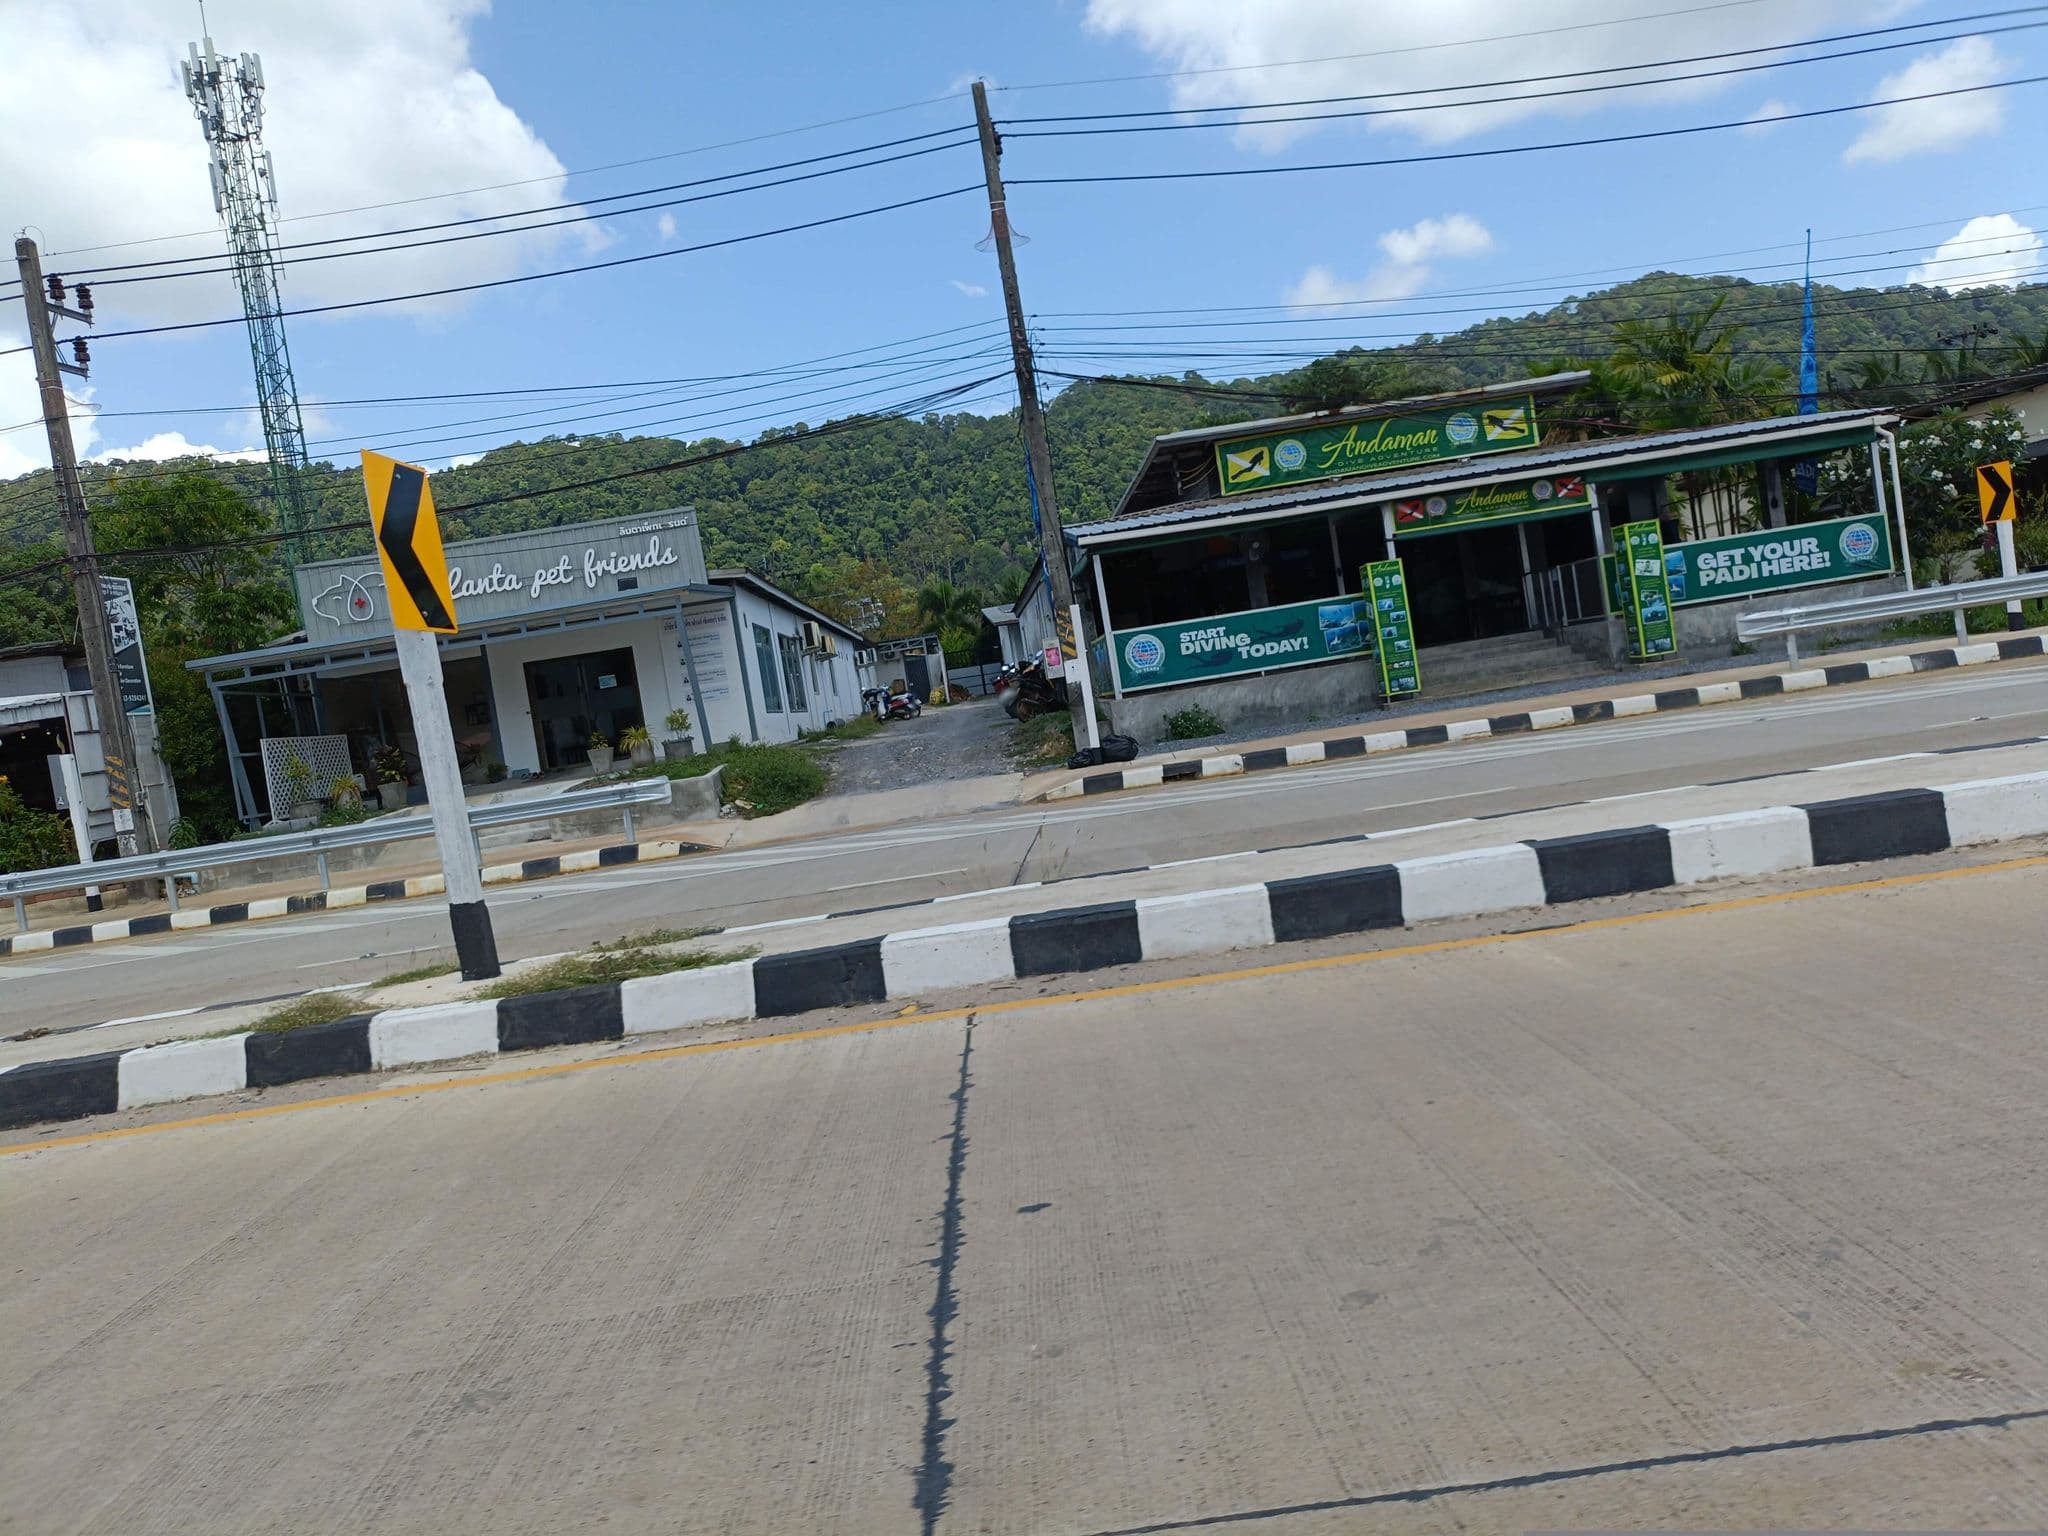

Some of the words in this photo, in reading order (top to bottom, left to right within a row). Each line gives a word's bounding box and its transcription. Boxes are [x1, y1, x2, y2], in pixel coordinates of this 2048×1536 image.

[1317, 418, 1438, 468] Andaman
[1337, 457, 1365, 467] DIVE
[1369, 446, 1439, 462] ADVENTURE
[1452, 485, 1528, 514] Andaman
[530, 554, 573, 598] pet
[584, 535, 679, 588] friends
[1696, 547, 1745, 570] GET
[1747, 537, 1819, 562] YOUR
[1698, 562, 1759, 587] PADI
[1761, 551, 1831, 577] HERE!
[1179, 626, 1226, 643] START
[1180, 632, 1251, 655] DIVING
[1237, 636, 1309, 659] TODAY!
